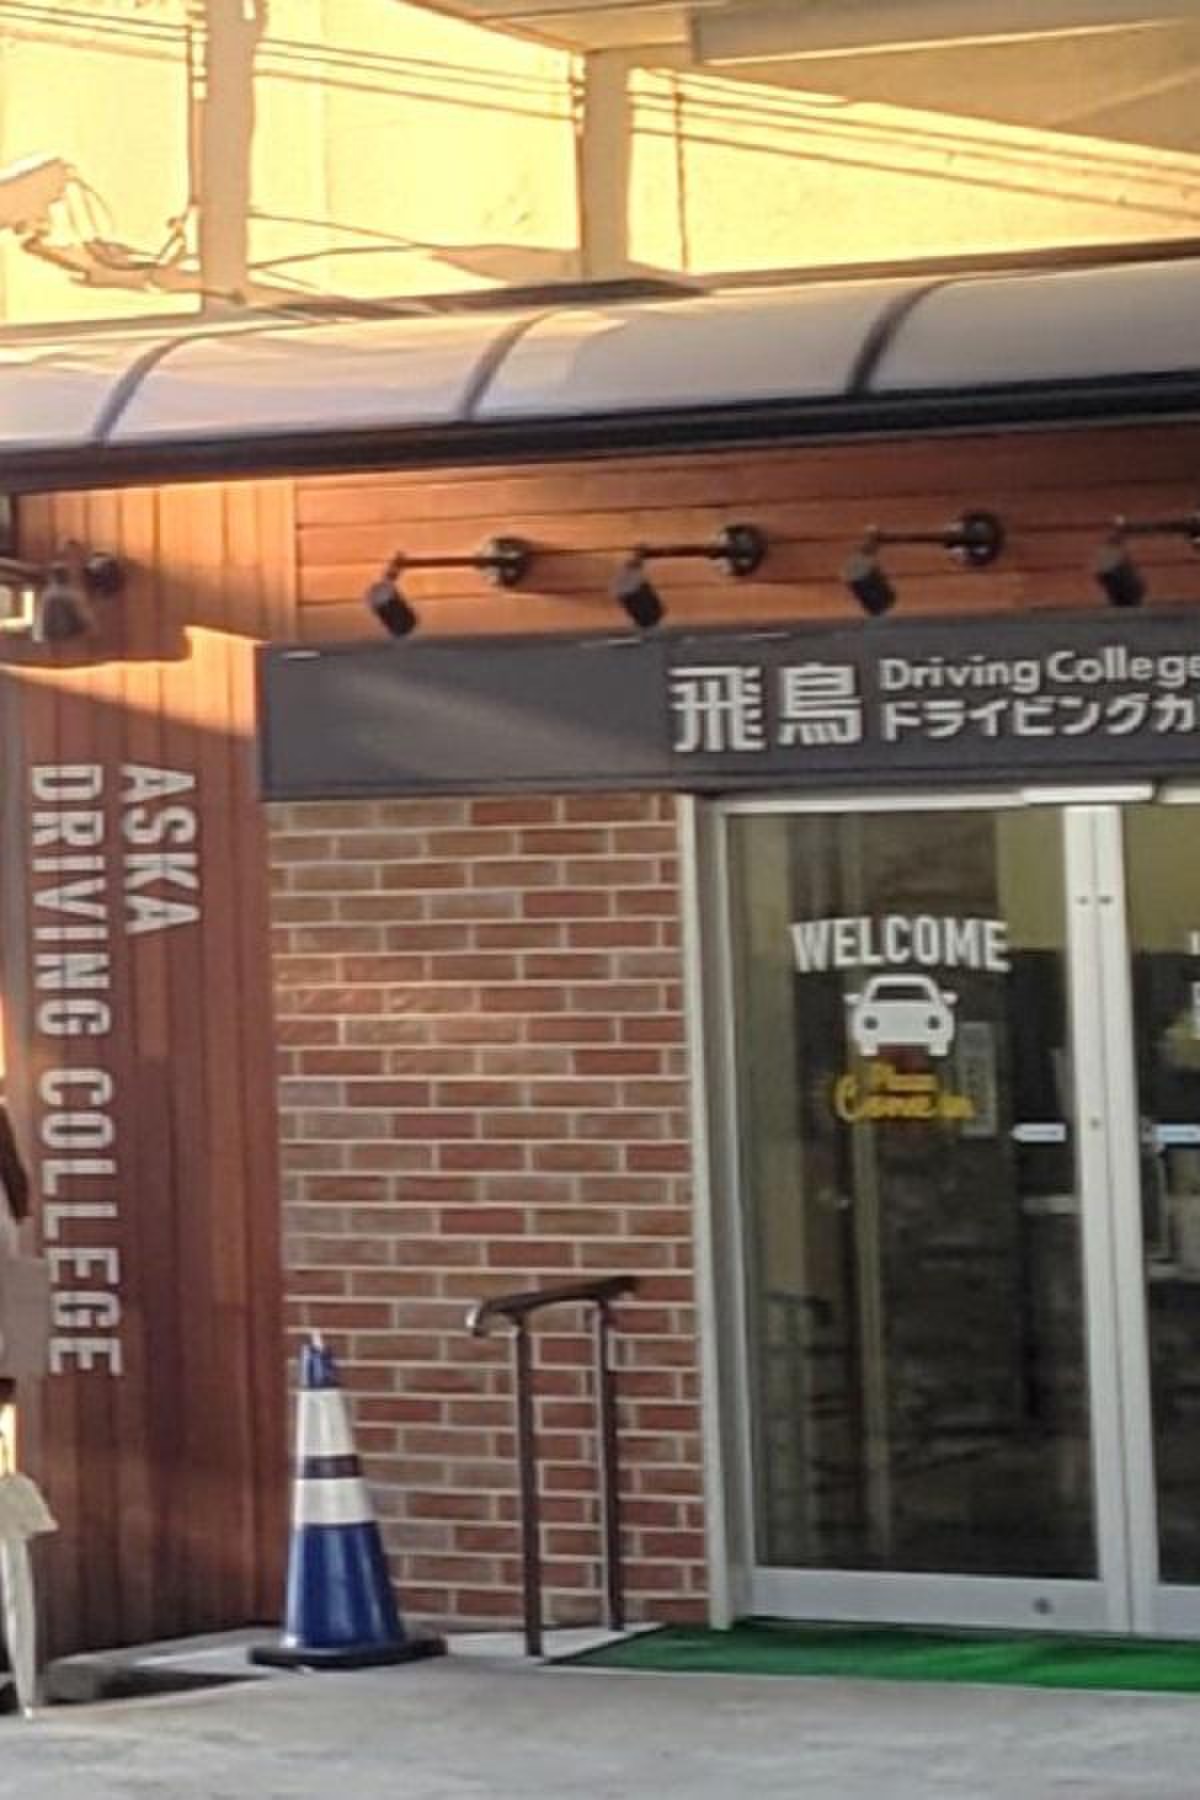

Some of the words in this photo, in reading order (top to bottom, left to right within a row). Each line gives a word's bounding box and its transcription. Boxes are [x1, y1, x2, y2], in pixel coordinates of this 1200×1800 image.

[668, 662, 867, 751] 飛鳥
[879, 655, 1040, 693] Driving
[31, 764, 112, 1036] DRIVING
[119, 764, 201, 935] ASKA
[790, 914, 1012, 974] WELCOME
[39, 1067, 123, 1376] COLLEGE
